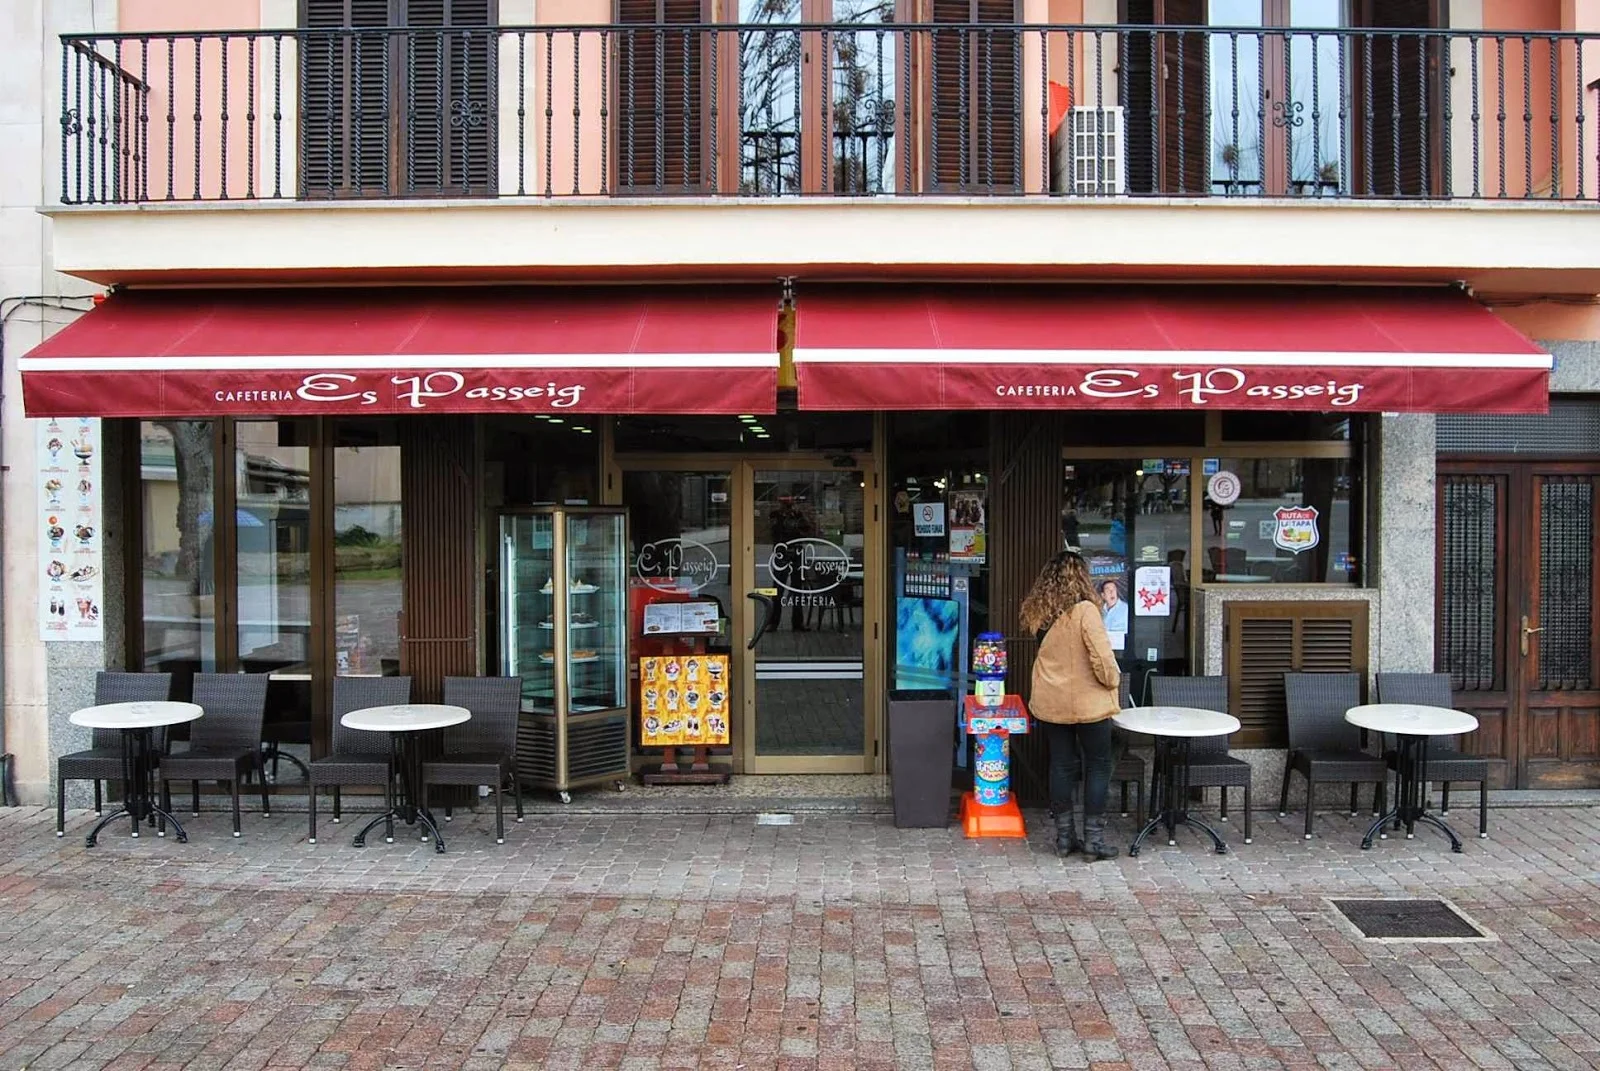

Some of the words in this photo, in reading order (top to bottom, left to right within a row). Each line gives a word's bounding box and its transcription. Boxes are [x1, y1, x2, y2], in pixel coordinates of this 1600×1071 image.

[214, 390, 294, 403] CAFETERIA
[296, 372, 378, 405] Es
[390, 371, 586, 409] Passeig
[994, 385, 1077, 397] CAFETERIA
[1078, 369, 1159, 398] Es
[1171, 366, 1364, 406] Passeig
[1282, 511, 1302, 519] RUTA
[640, 543, 662, 575] Es
[663, 543, 714, 583] Passeig
[772, 543, 794, 575] Es
[796, 543, 846, 582] Passeig
[780, 596, 836, 607] CAFETERIA
